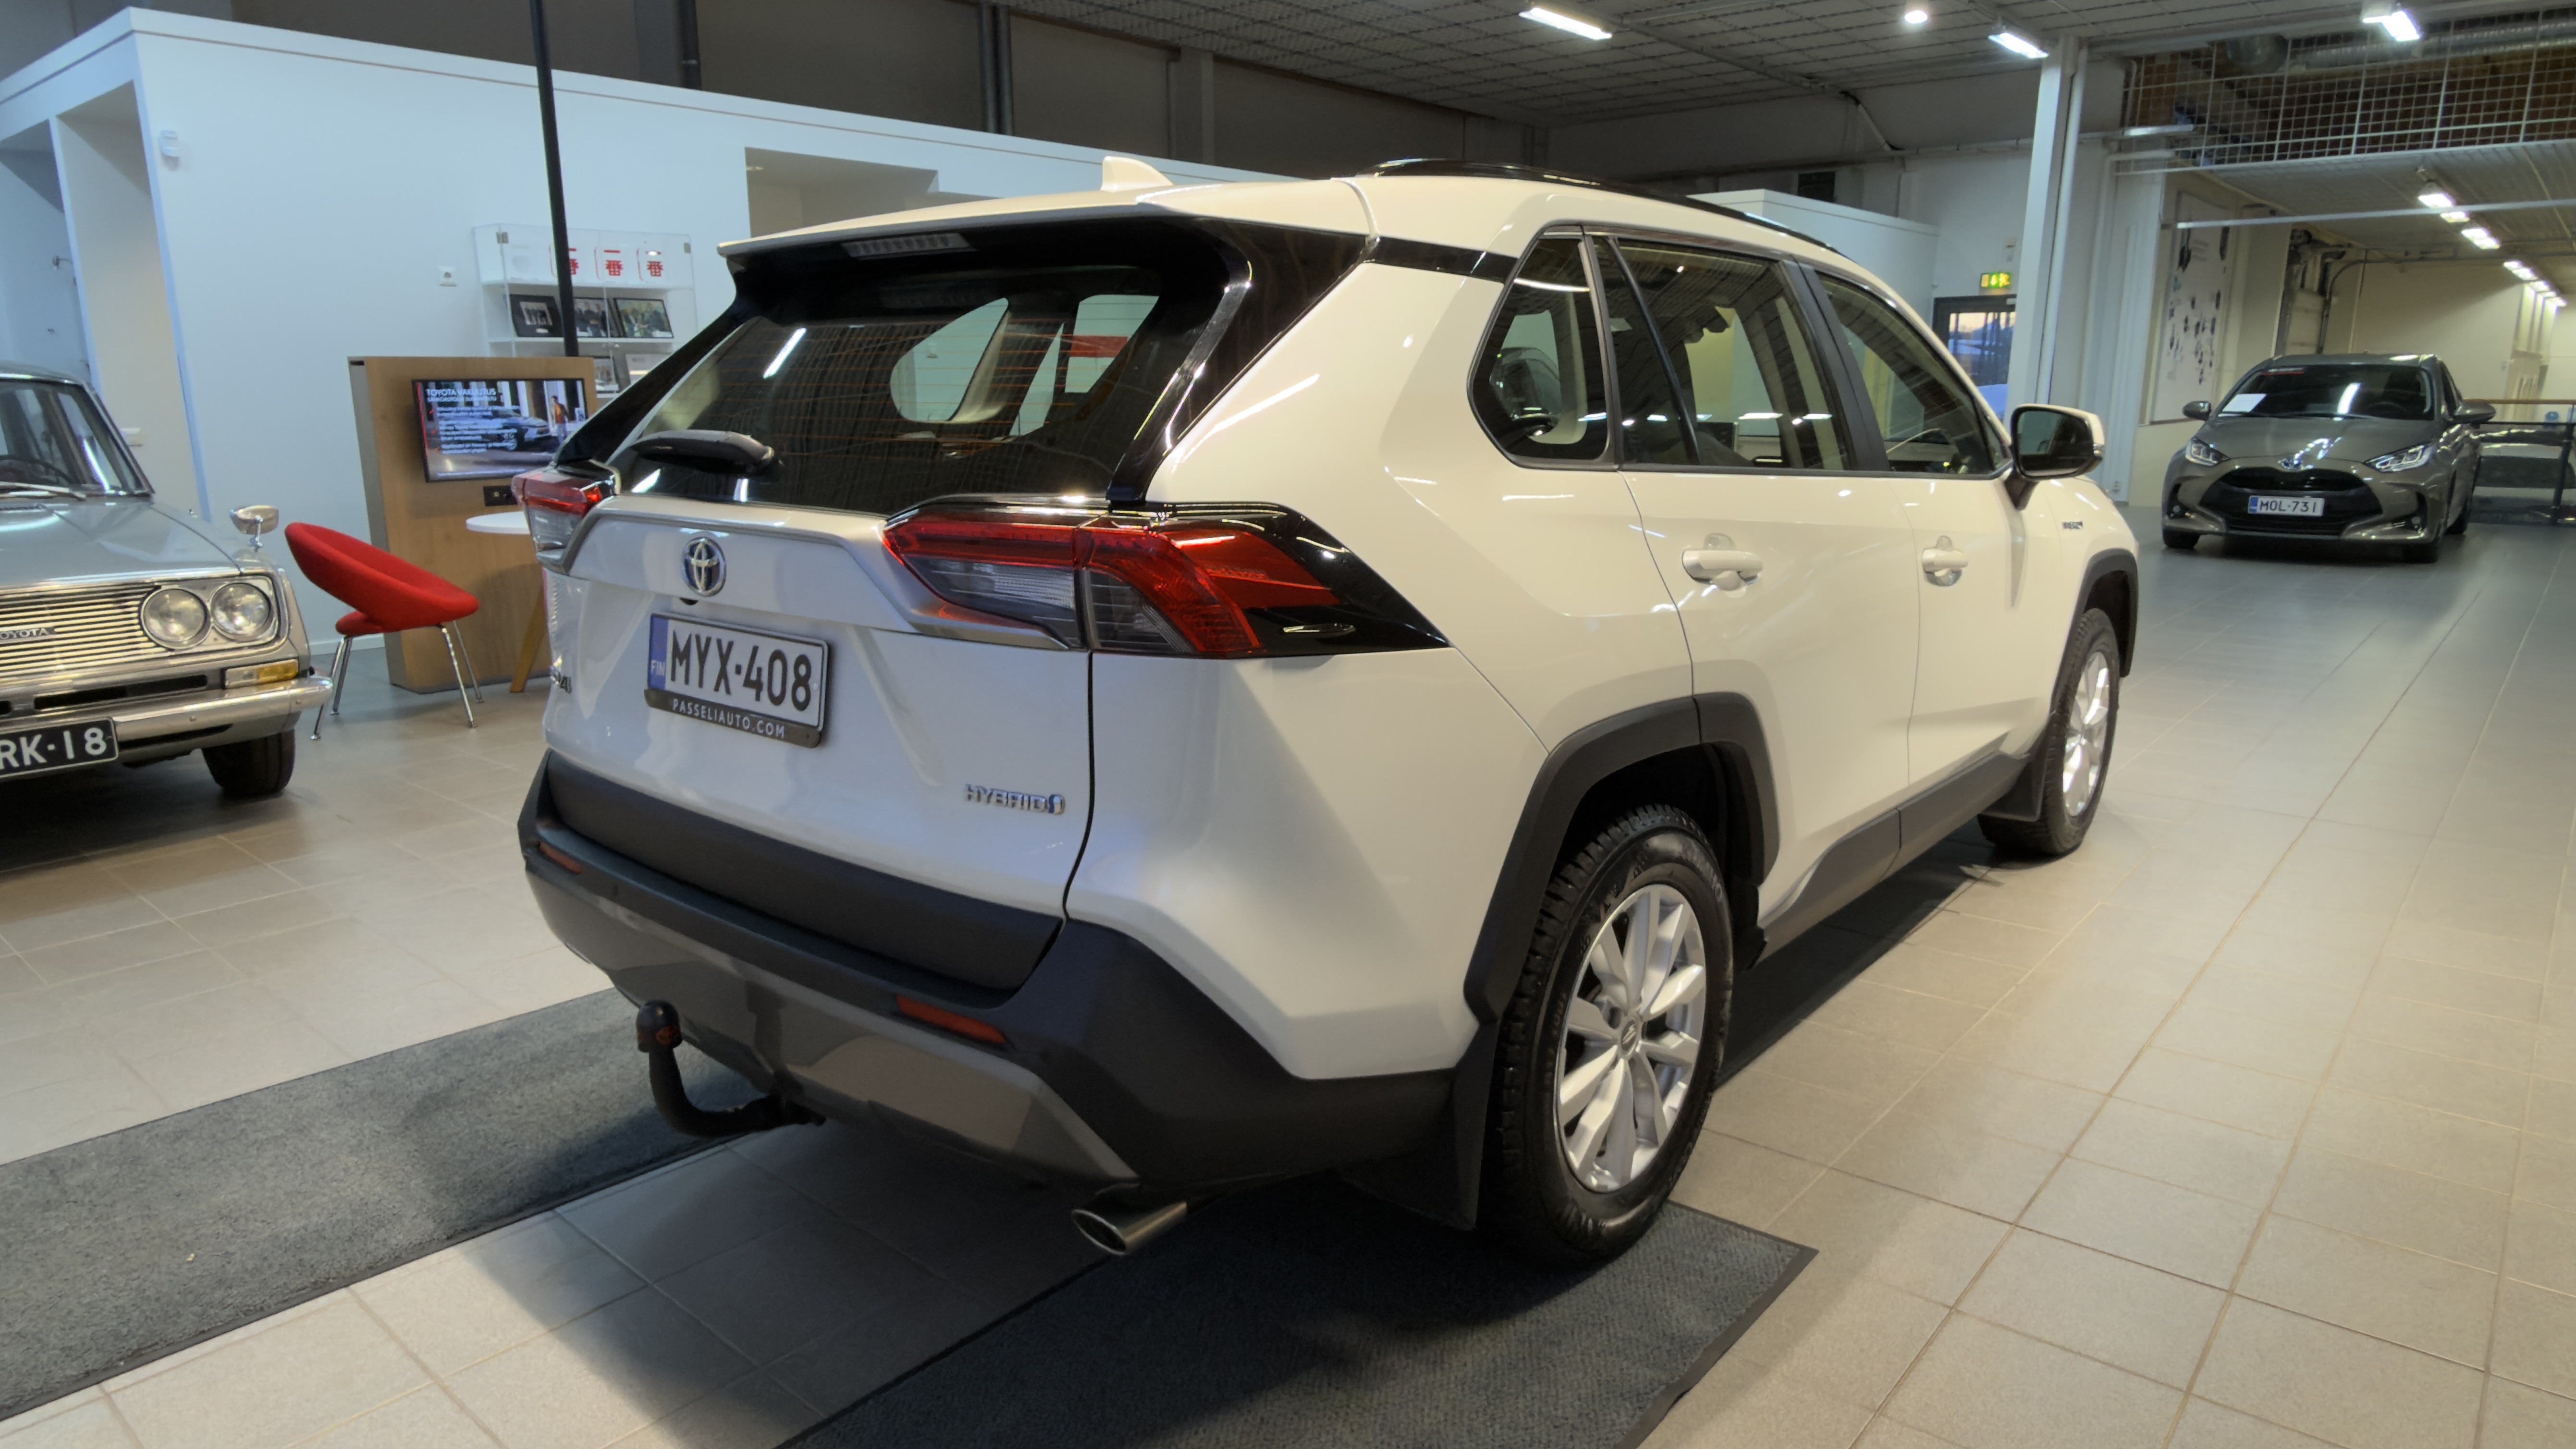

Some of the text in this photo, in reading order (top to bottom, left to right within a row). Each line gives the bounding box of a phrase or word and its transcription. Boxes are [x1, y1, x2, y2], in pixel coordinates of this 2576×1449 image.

[426, 388, 456, 396] TOYOTA
[2259, 500, 2317, 513] MOL-731
[650, 660, 666, 676] FIN
[671, 629, 811, 711] MYX-408
[673, 698, 785, 738] PASSELIAUTO.COM
[964, 783, 1047, 813] HYBRID
